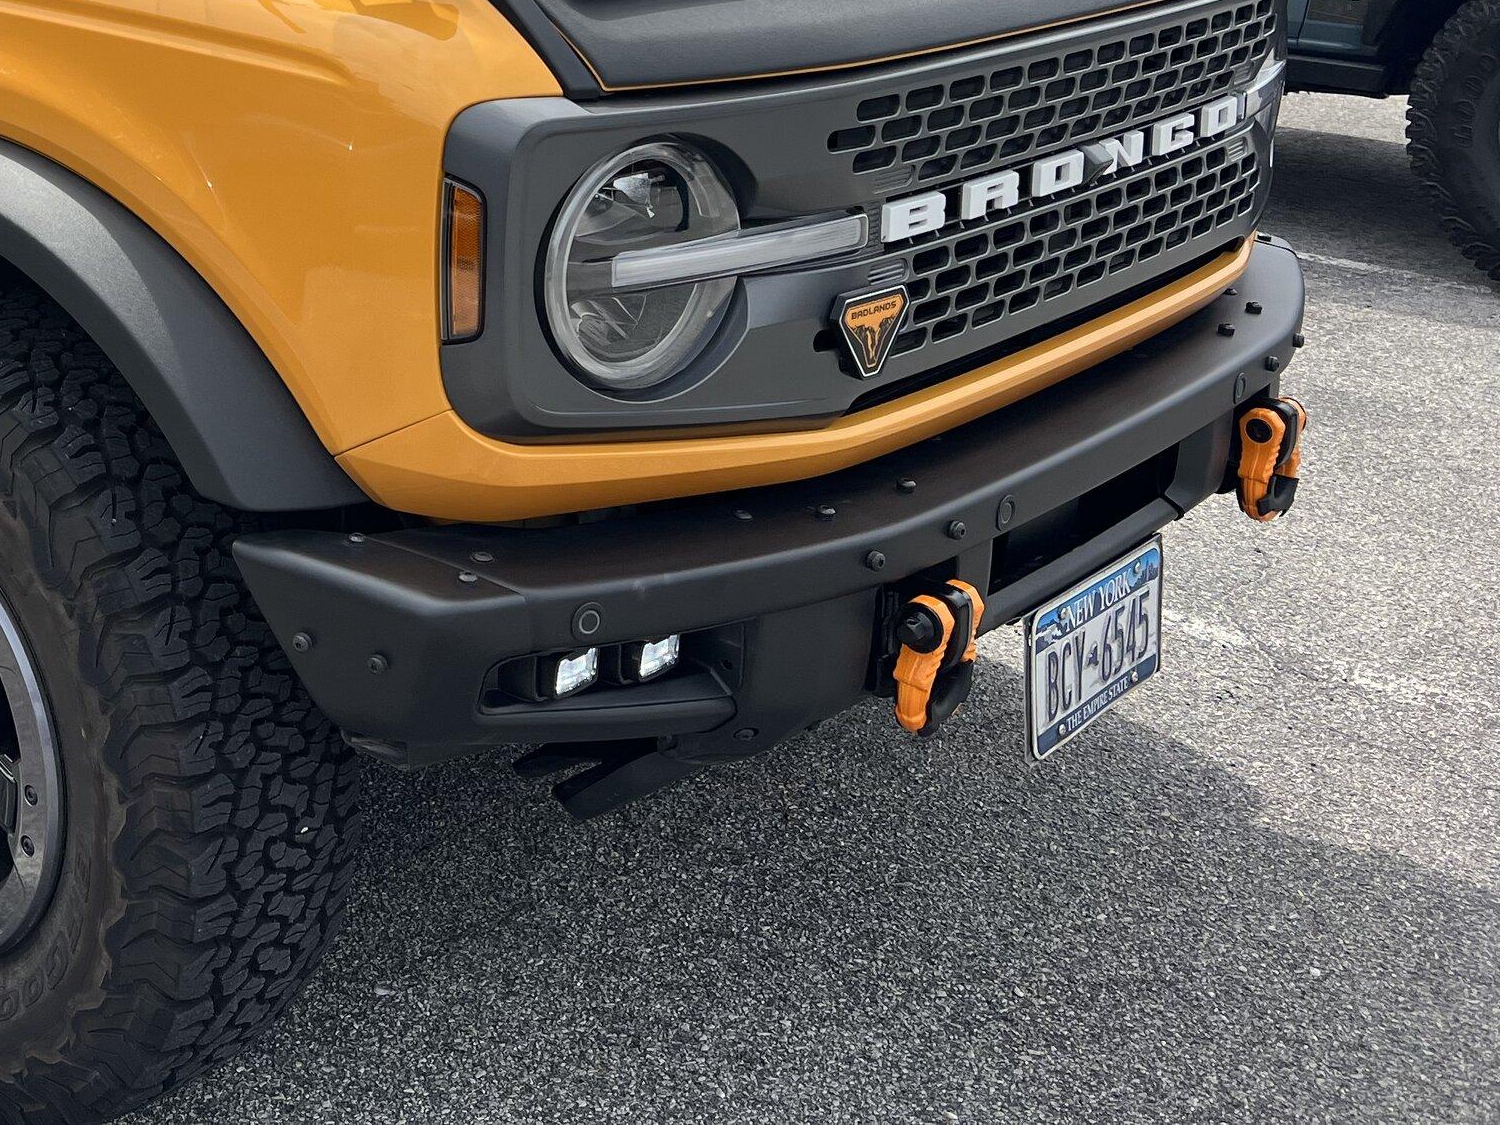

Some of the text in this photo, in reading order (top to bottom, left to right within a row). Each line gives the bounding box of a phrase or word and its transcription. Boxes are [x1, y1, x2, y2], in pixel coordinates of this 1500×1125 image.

[881, 96, 1237, 242] BRONCO
[851, 300, 897, 321] BADLANDS
[1065, 569, 1131, 631] NEW YORK
[1047, 590, 1149, 721] BCY 6545
[1067, 677, 1130, 731] THE EMPIRE STATE
